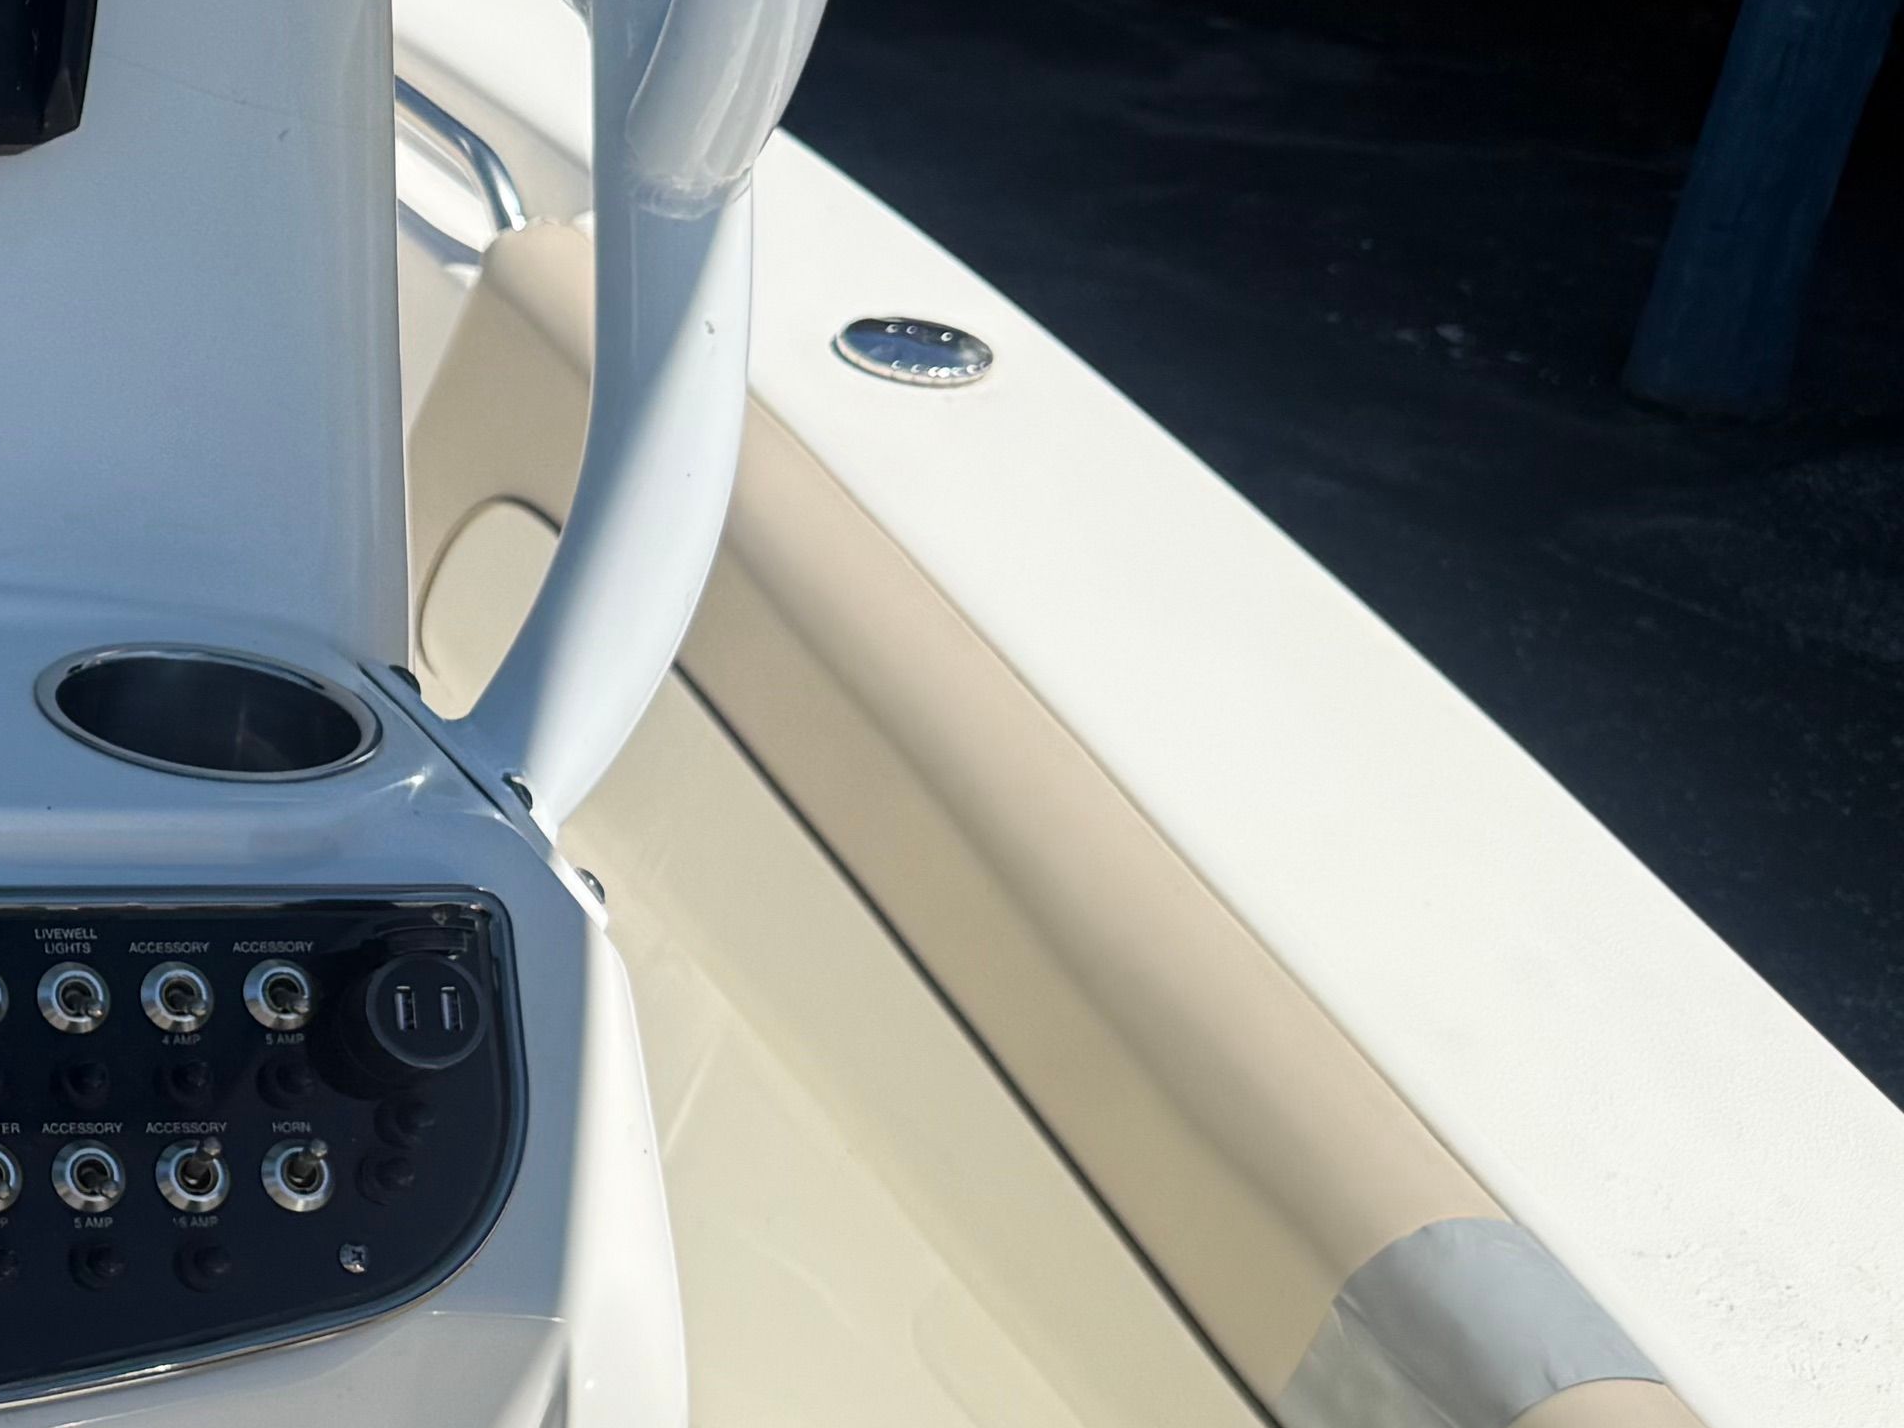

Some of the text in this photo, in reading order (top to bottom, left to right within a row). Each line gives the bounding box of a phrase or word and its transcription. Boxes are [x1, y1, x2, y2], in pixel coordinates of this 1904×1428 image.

[34, 928, 98, 940] LIVEWELL
[44, 942, 91, 954] LIGHTS
[129, 942, 210, 953] ACCESSORY
[232, 941, 314, 953] ACCESSORY
[172, 1034, 201, 1045] AMP
[276, 1033, 305, 1045] AMP
[41, 1122, 123, 1134] ACCESSORY
[145, 1122, 228, 1134] ACCESSORY
[272, 1122, 311, 1133] HORN
[84, 1217, 113, 1228] AMP
